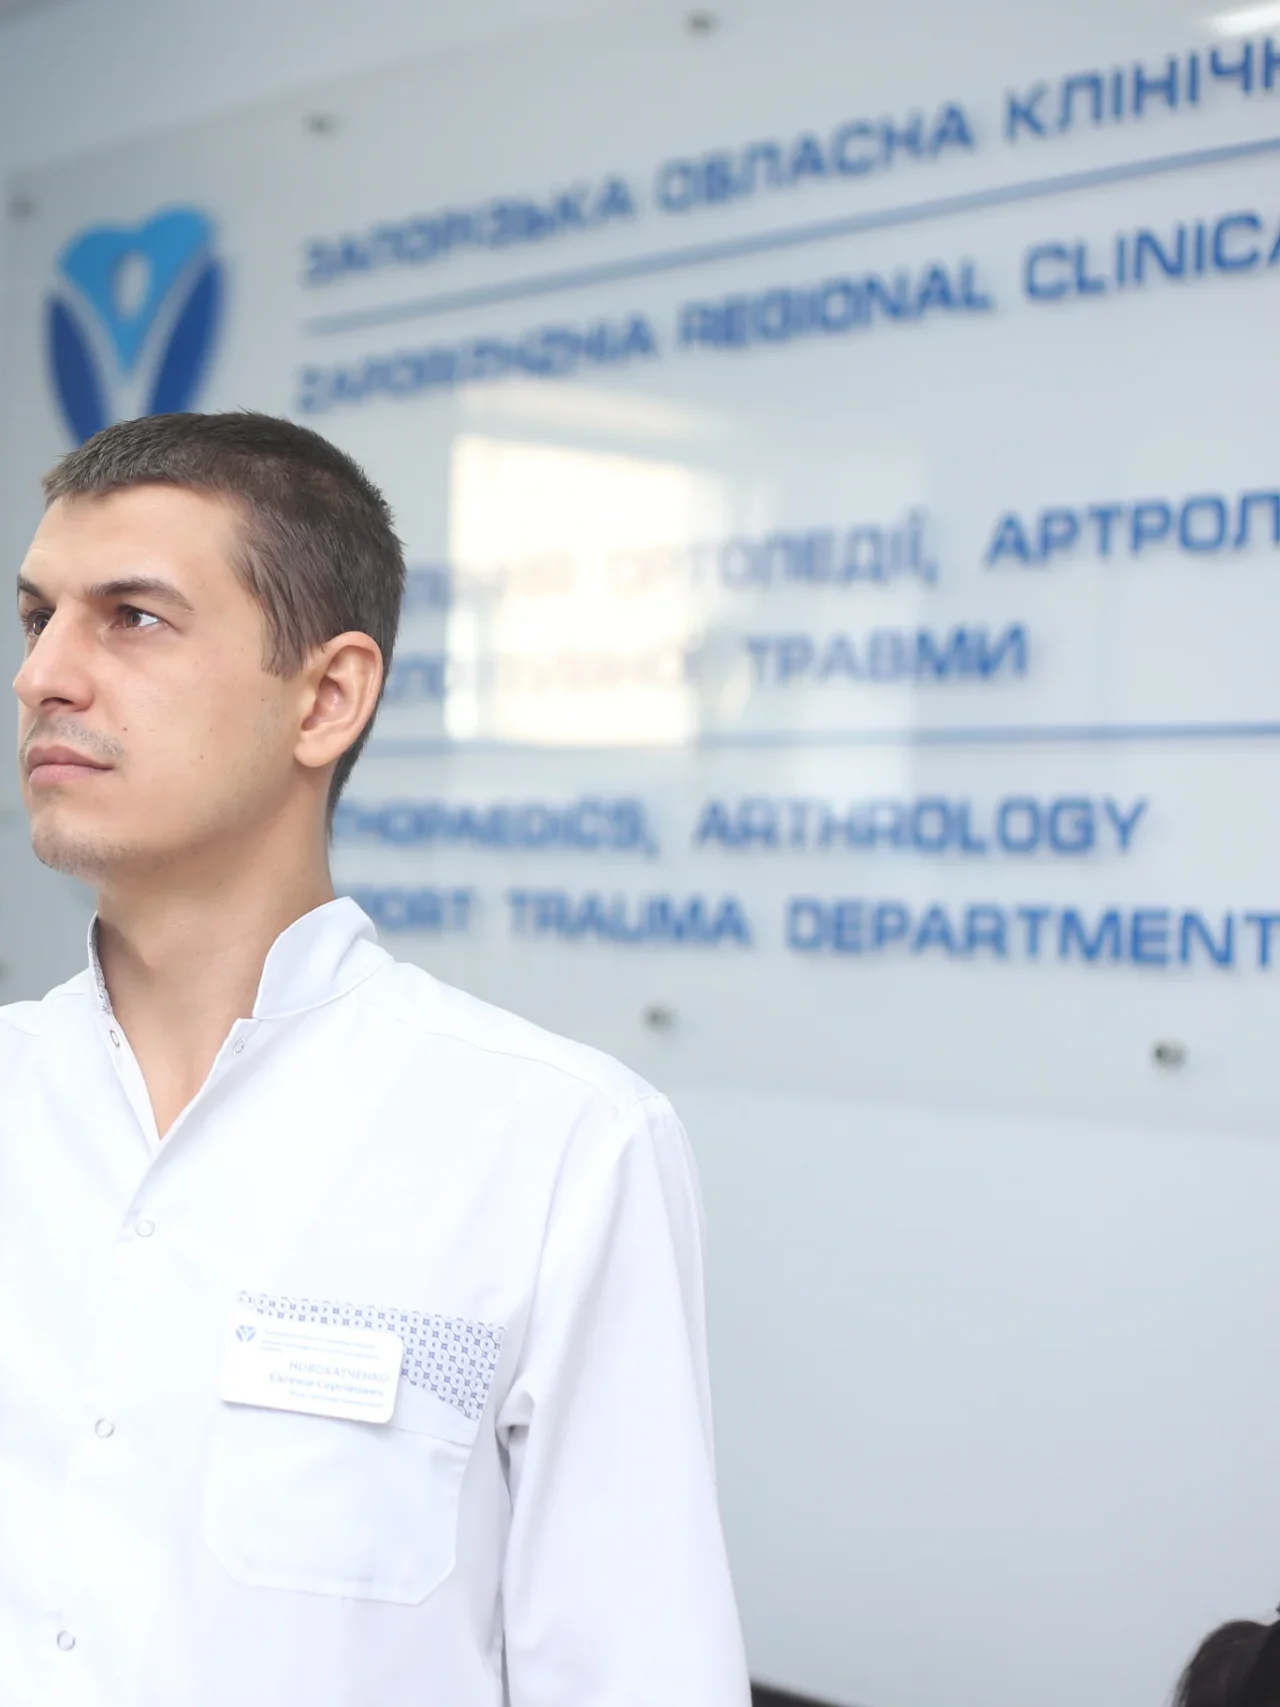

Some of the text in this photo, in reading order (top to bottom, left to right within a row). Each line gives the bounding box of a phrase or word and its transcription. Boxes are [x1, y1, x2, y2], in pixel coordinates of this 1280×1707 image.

[656, 102, 974, 211] ОБЛАСНА
[678, 256, 993, 350] REGIONAL
[1025, 210, 1280, 301] CLINIC
[745, 620, 1028, 685] ТРАВМИ
[691, 795, 1150, 857] ARTHROLOGY
[340, 885, 1280, 970] PORT TRAUMA DEPARTMENT
